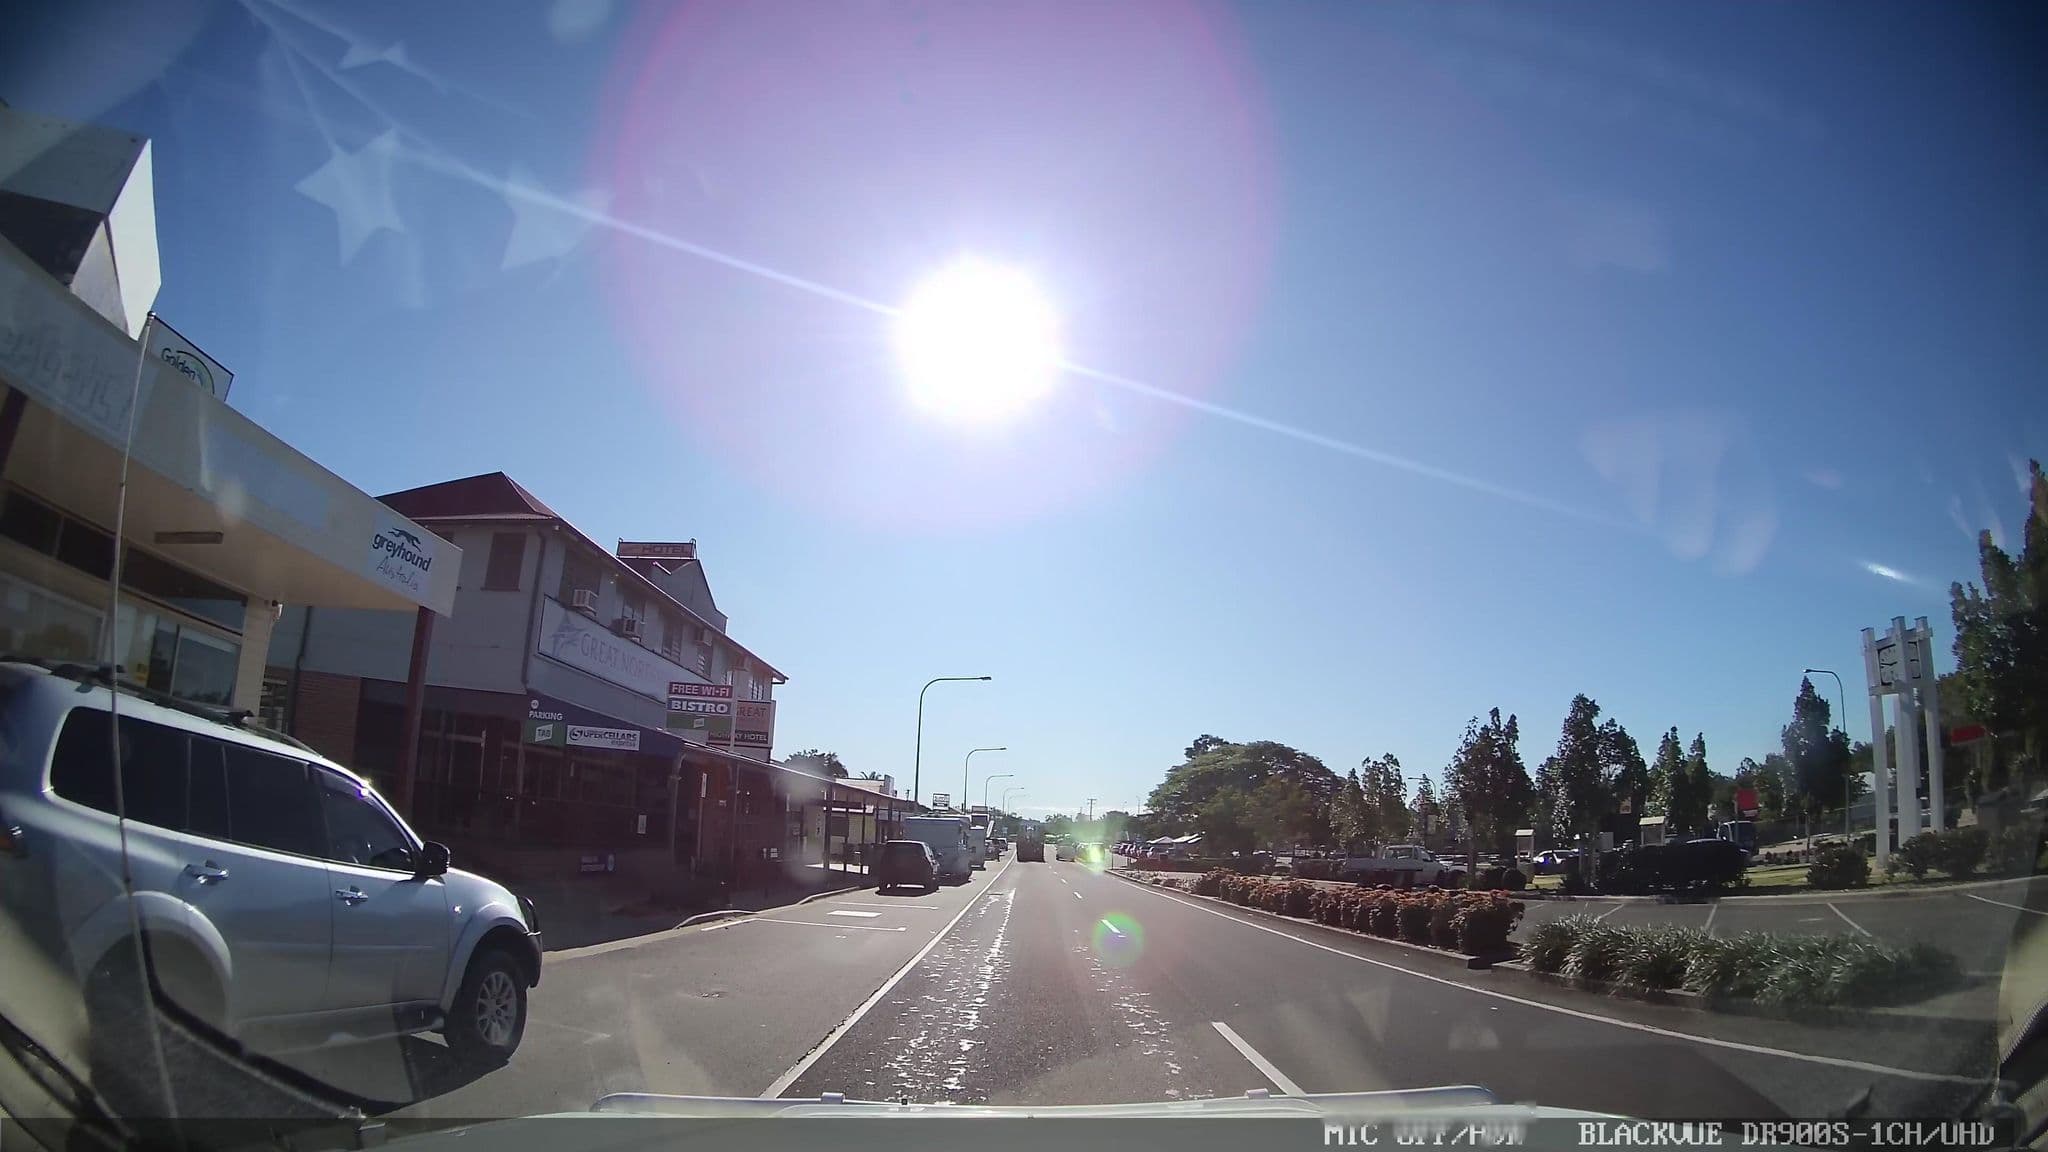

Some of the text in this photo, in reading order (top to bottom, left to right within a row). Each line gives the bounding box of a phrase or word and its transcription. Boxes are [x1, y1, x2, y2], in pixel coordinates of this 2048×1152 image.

[161, 348, 196, 381] Golden
[372, 533, 432, 571] greyhound
[641, 544, 689, 554] HOTEL
[376, 556, 418, 591] Australia
[580, 632, 617, 667] GREAT
[672, 684, 699, 695] FREE
[671, 700, 728, 713] BISTRO
[528, 710, 563, 721] PARKING
[537, 729, 551, 738] TAB
[744, 733, 767, 741] HOTEL
